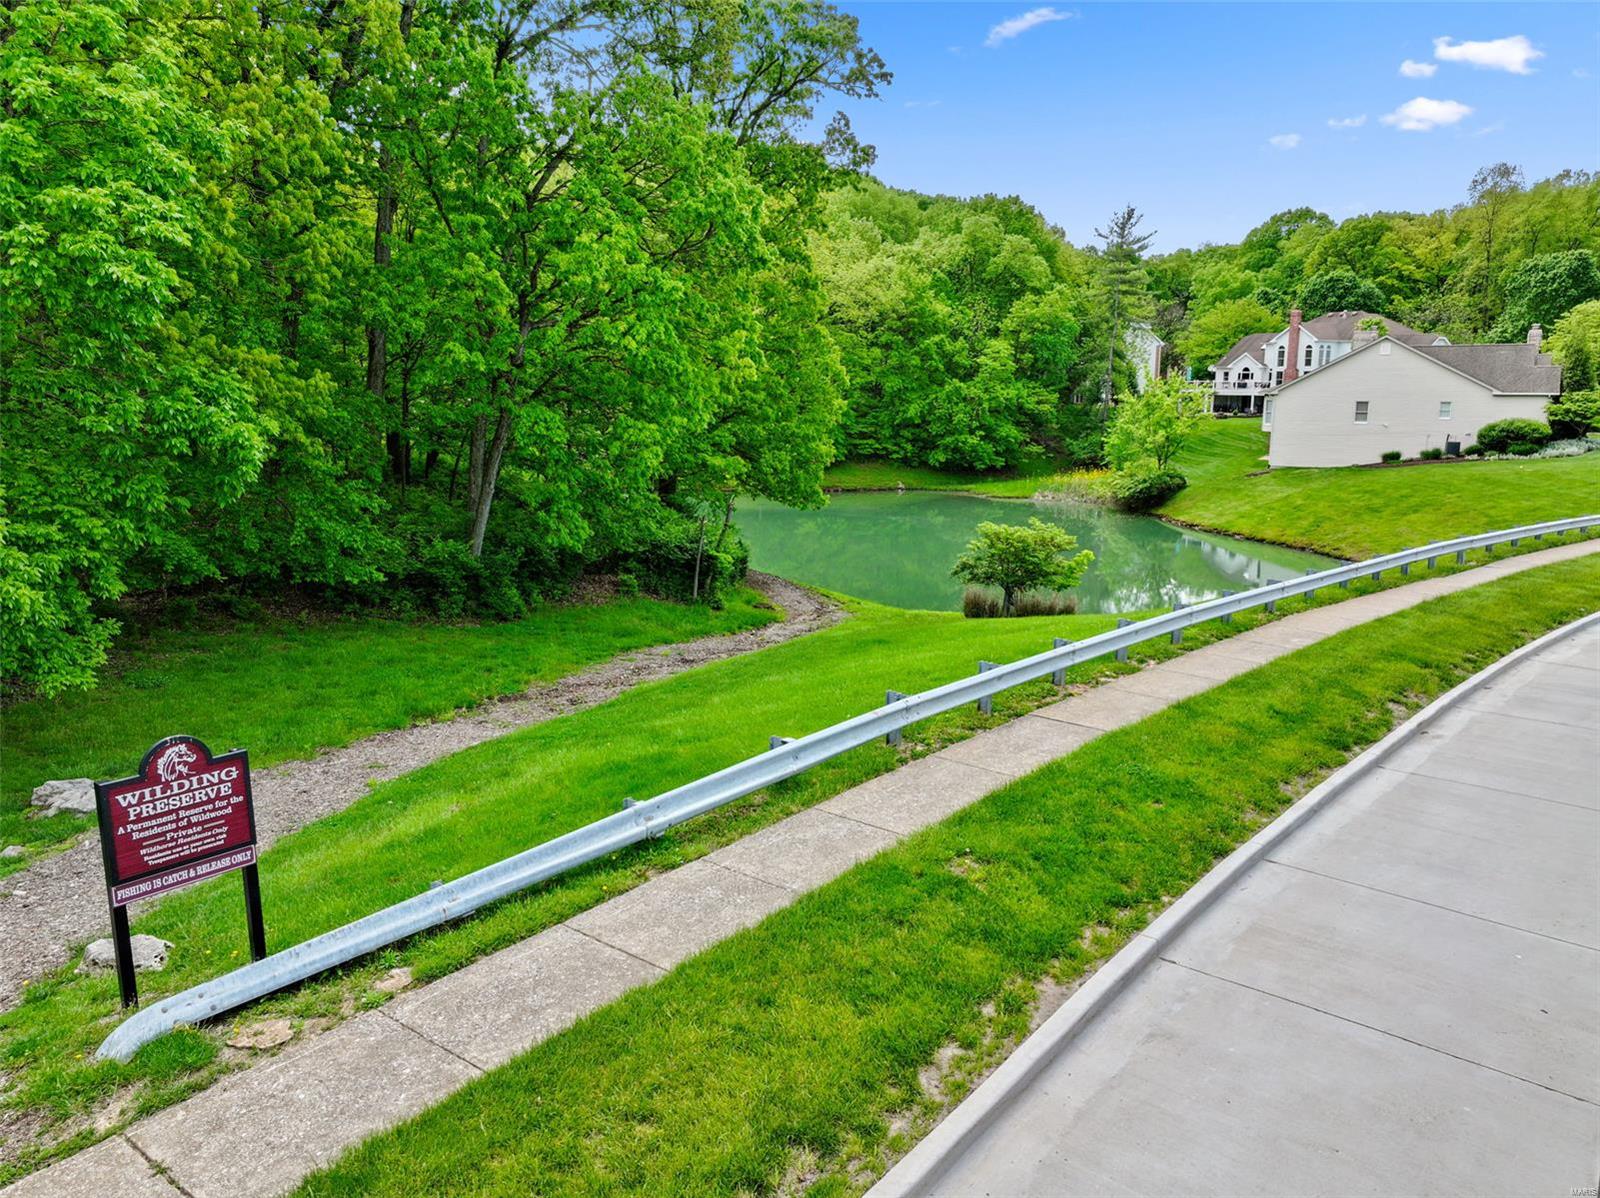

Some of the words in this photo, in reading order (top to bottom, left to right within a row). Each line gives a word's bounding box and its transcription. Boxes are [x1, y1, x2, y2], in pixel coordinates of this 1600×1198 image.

[115, 766, 239, 807] WILDING
[128, 782, 233, 821] PRESERVE
[117, 827, 125, 835] A
[126, 813, 177, 832] Permanent
[178, 803, 214, 817] Reserve
[214, 799, 229, 808] for
[230, 795, 244, 804] the
[131, 822, 177, 840] Residents
[178, 819, 188, 828] of
[189, 807, 233, 824] Wildwood
[165, 826, 203, 841] Private
[139, 841, 177, 855] Wildhorse
[177, 831, 212, 845] Residents
[212, 826, 229, 836] Only
[116, 882, 152, 900] FISHING
[153, 879, 162, 888] IS
[162, 869, 189, 885] CATCH
[189, 868, 197, 878] &
[196, 857, 231, 875] RELEASE
[231, 850, 252, 864] ONLY
